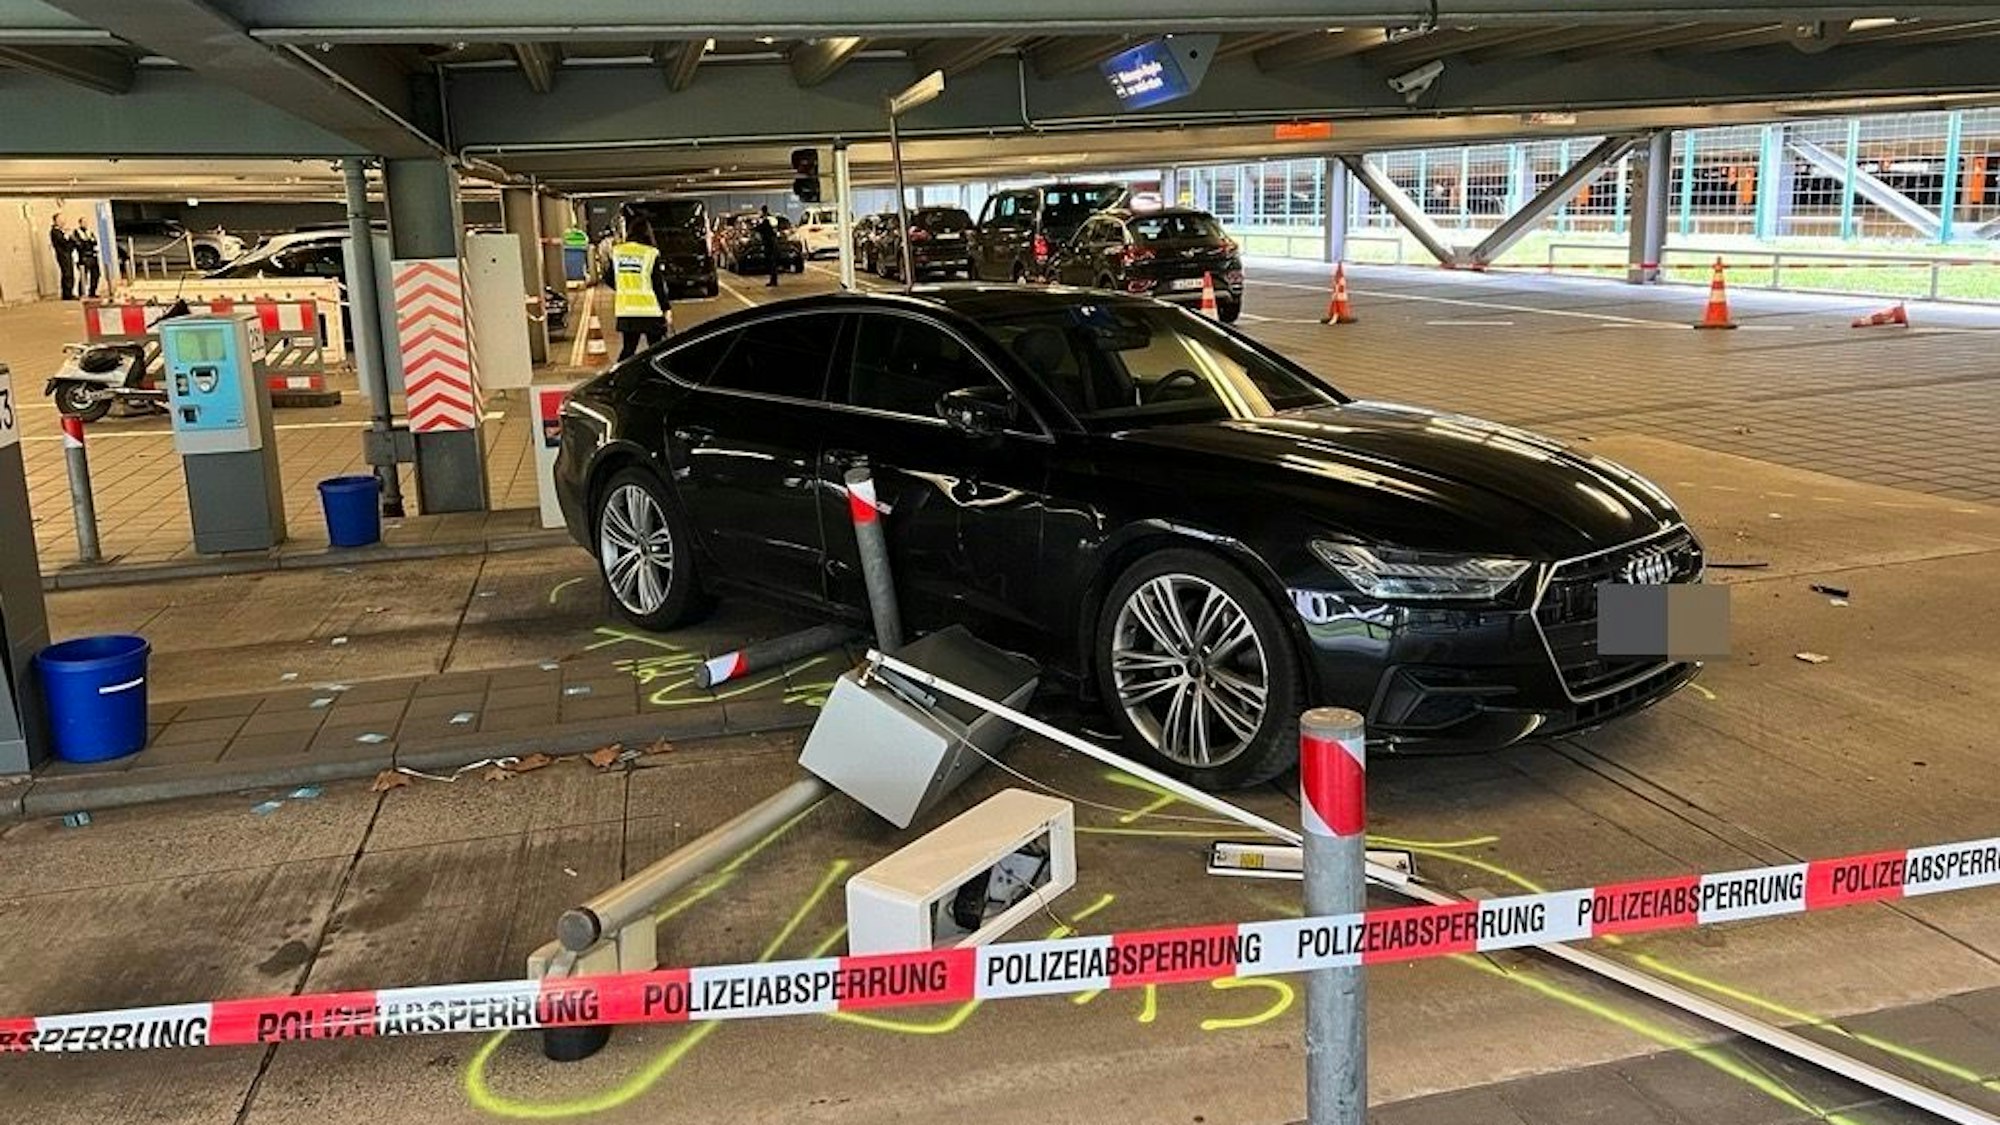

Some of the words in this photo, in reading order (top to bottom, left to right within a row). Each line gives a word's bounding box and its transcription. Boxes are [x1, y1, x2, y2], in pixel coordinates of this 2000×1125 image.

[257, 988, 599, 1042] POLIZEIABSPERRUNG
[644, 960, 947, 1016] POLIZEIABSPERRUNG
[987, 933, 1262, 987] POLIZEIABSPERRUNG
[1297, 903, 1546, 959] POLIZEIABSPERRUNG
[1577, 873, 1803, 927] POLIZEIABSPERRUNG
[1832, 847, 2000, 895] POLIZEIABSPERR
